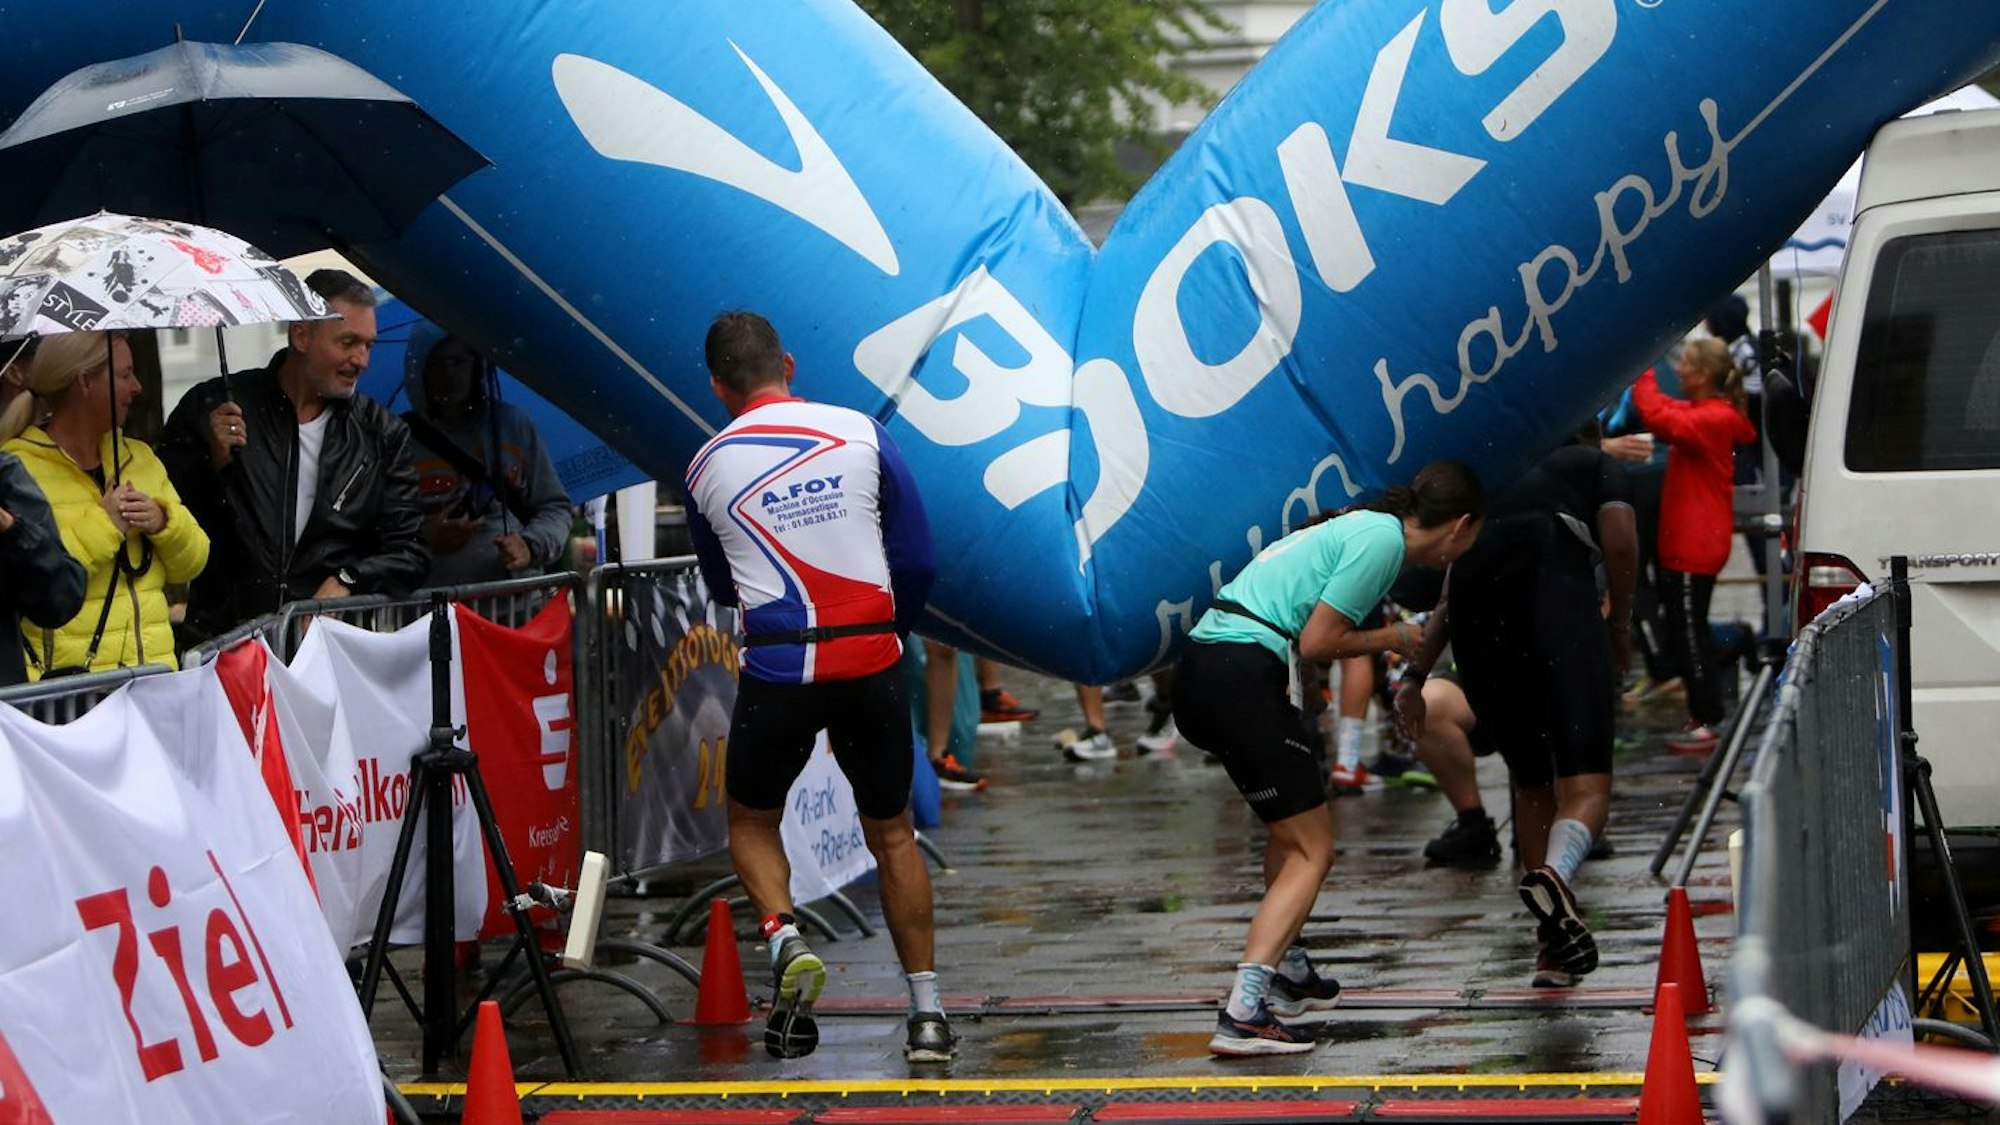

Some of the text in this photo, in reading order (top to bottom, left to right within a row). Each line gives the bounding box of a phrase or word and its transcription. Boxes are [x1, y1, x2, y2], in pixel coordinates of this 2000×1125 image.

[1372, 97, 1736, 465] happy
[43, 289, 101, 331] STYLE
[762, 474, 844, 507] A.FOY
[766, 499, 800, 515] Machine
[1877, 552, 2000, 570] TANSPORT
[75, 849, 295, 1083] Ziel
